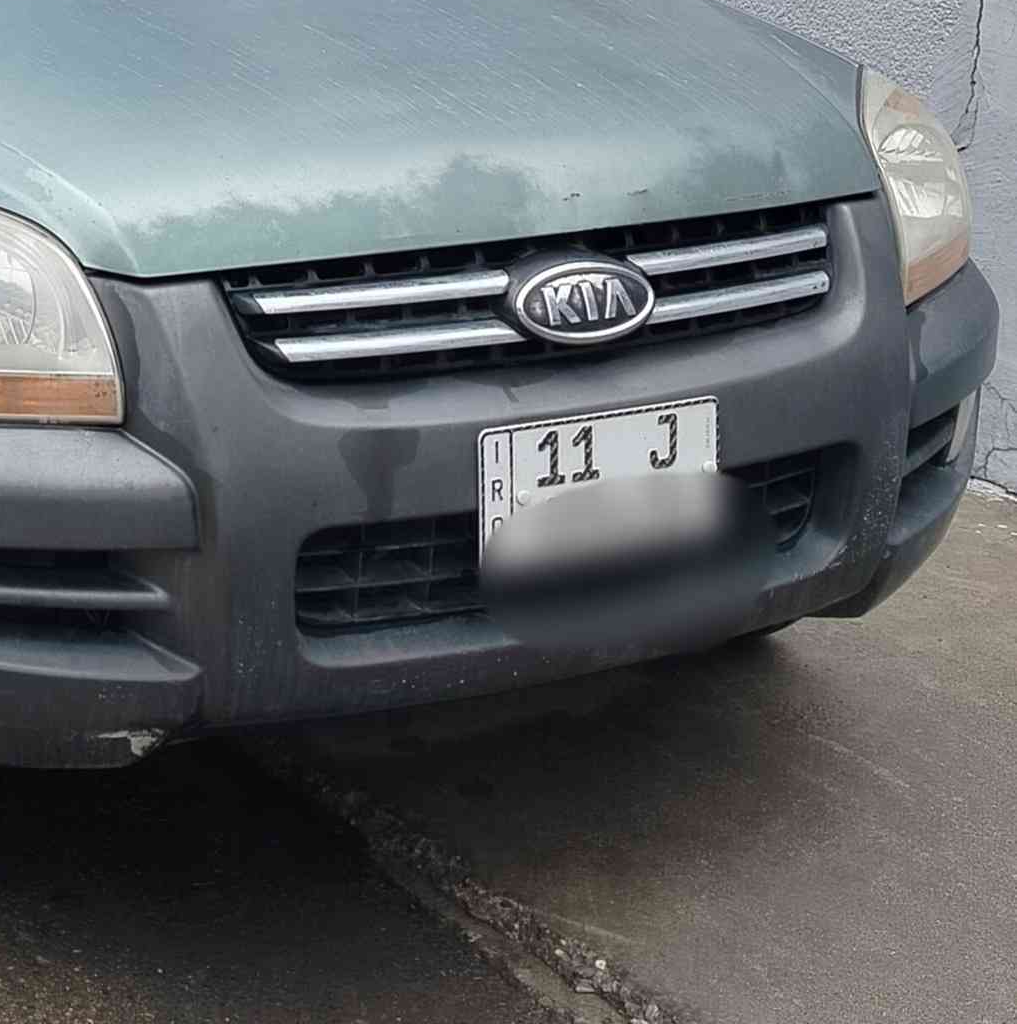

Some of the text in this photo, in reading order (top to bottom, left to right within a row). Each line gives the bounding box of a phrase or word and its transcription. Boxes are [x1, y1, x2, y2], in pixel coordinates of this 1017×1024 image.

[541, 277, 637, 326] KIA
[537, 425, 600, 487] 11
[649, 413, 678, 469] J
